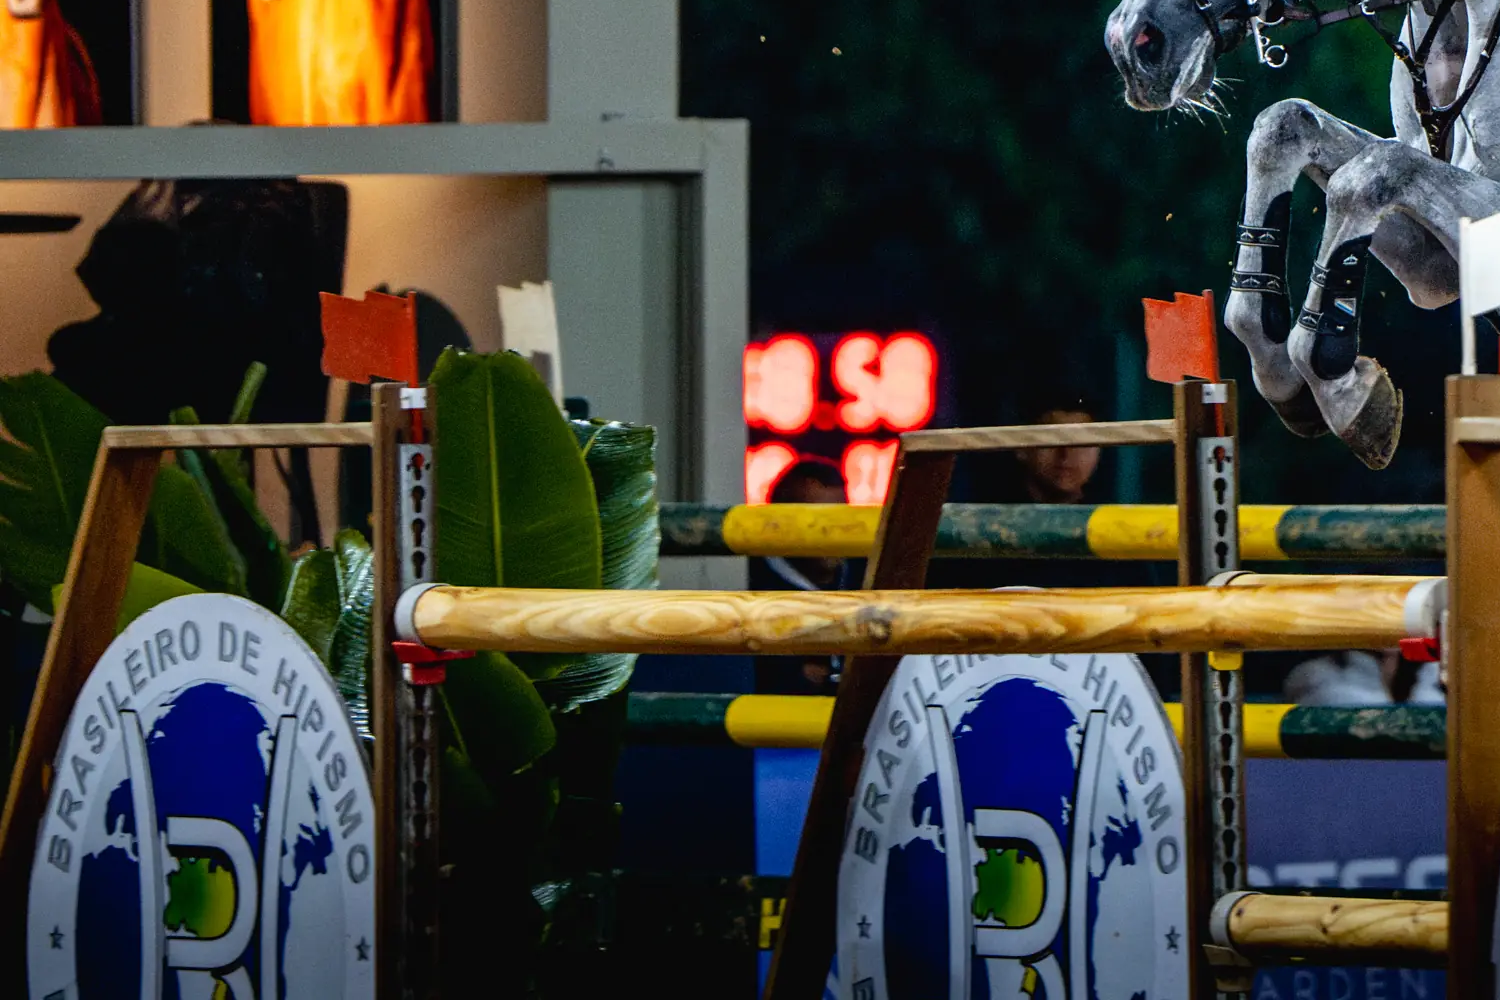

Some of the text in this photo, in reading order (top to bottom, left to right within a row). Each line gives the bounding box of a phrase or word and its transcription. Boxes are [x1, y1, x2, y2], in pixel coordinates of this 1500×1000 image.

[48, 620, 371, 884] BRASILEIRO DE HIPISMO
[1082, 655, 1178, 875] HIPISMO
